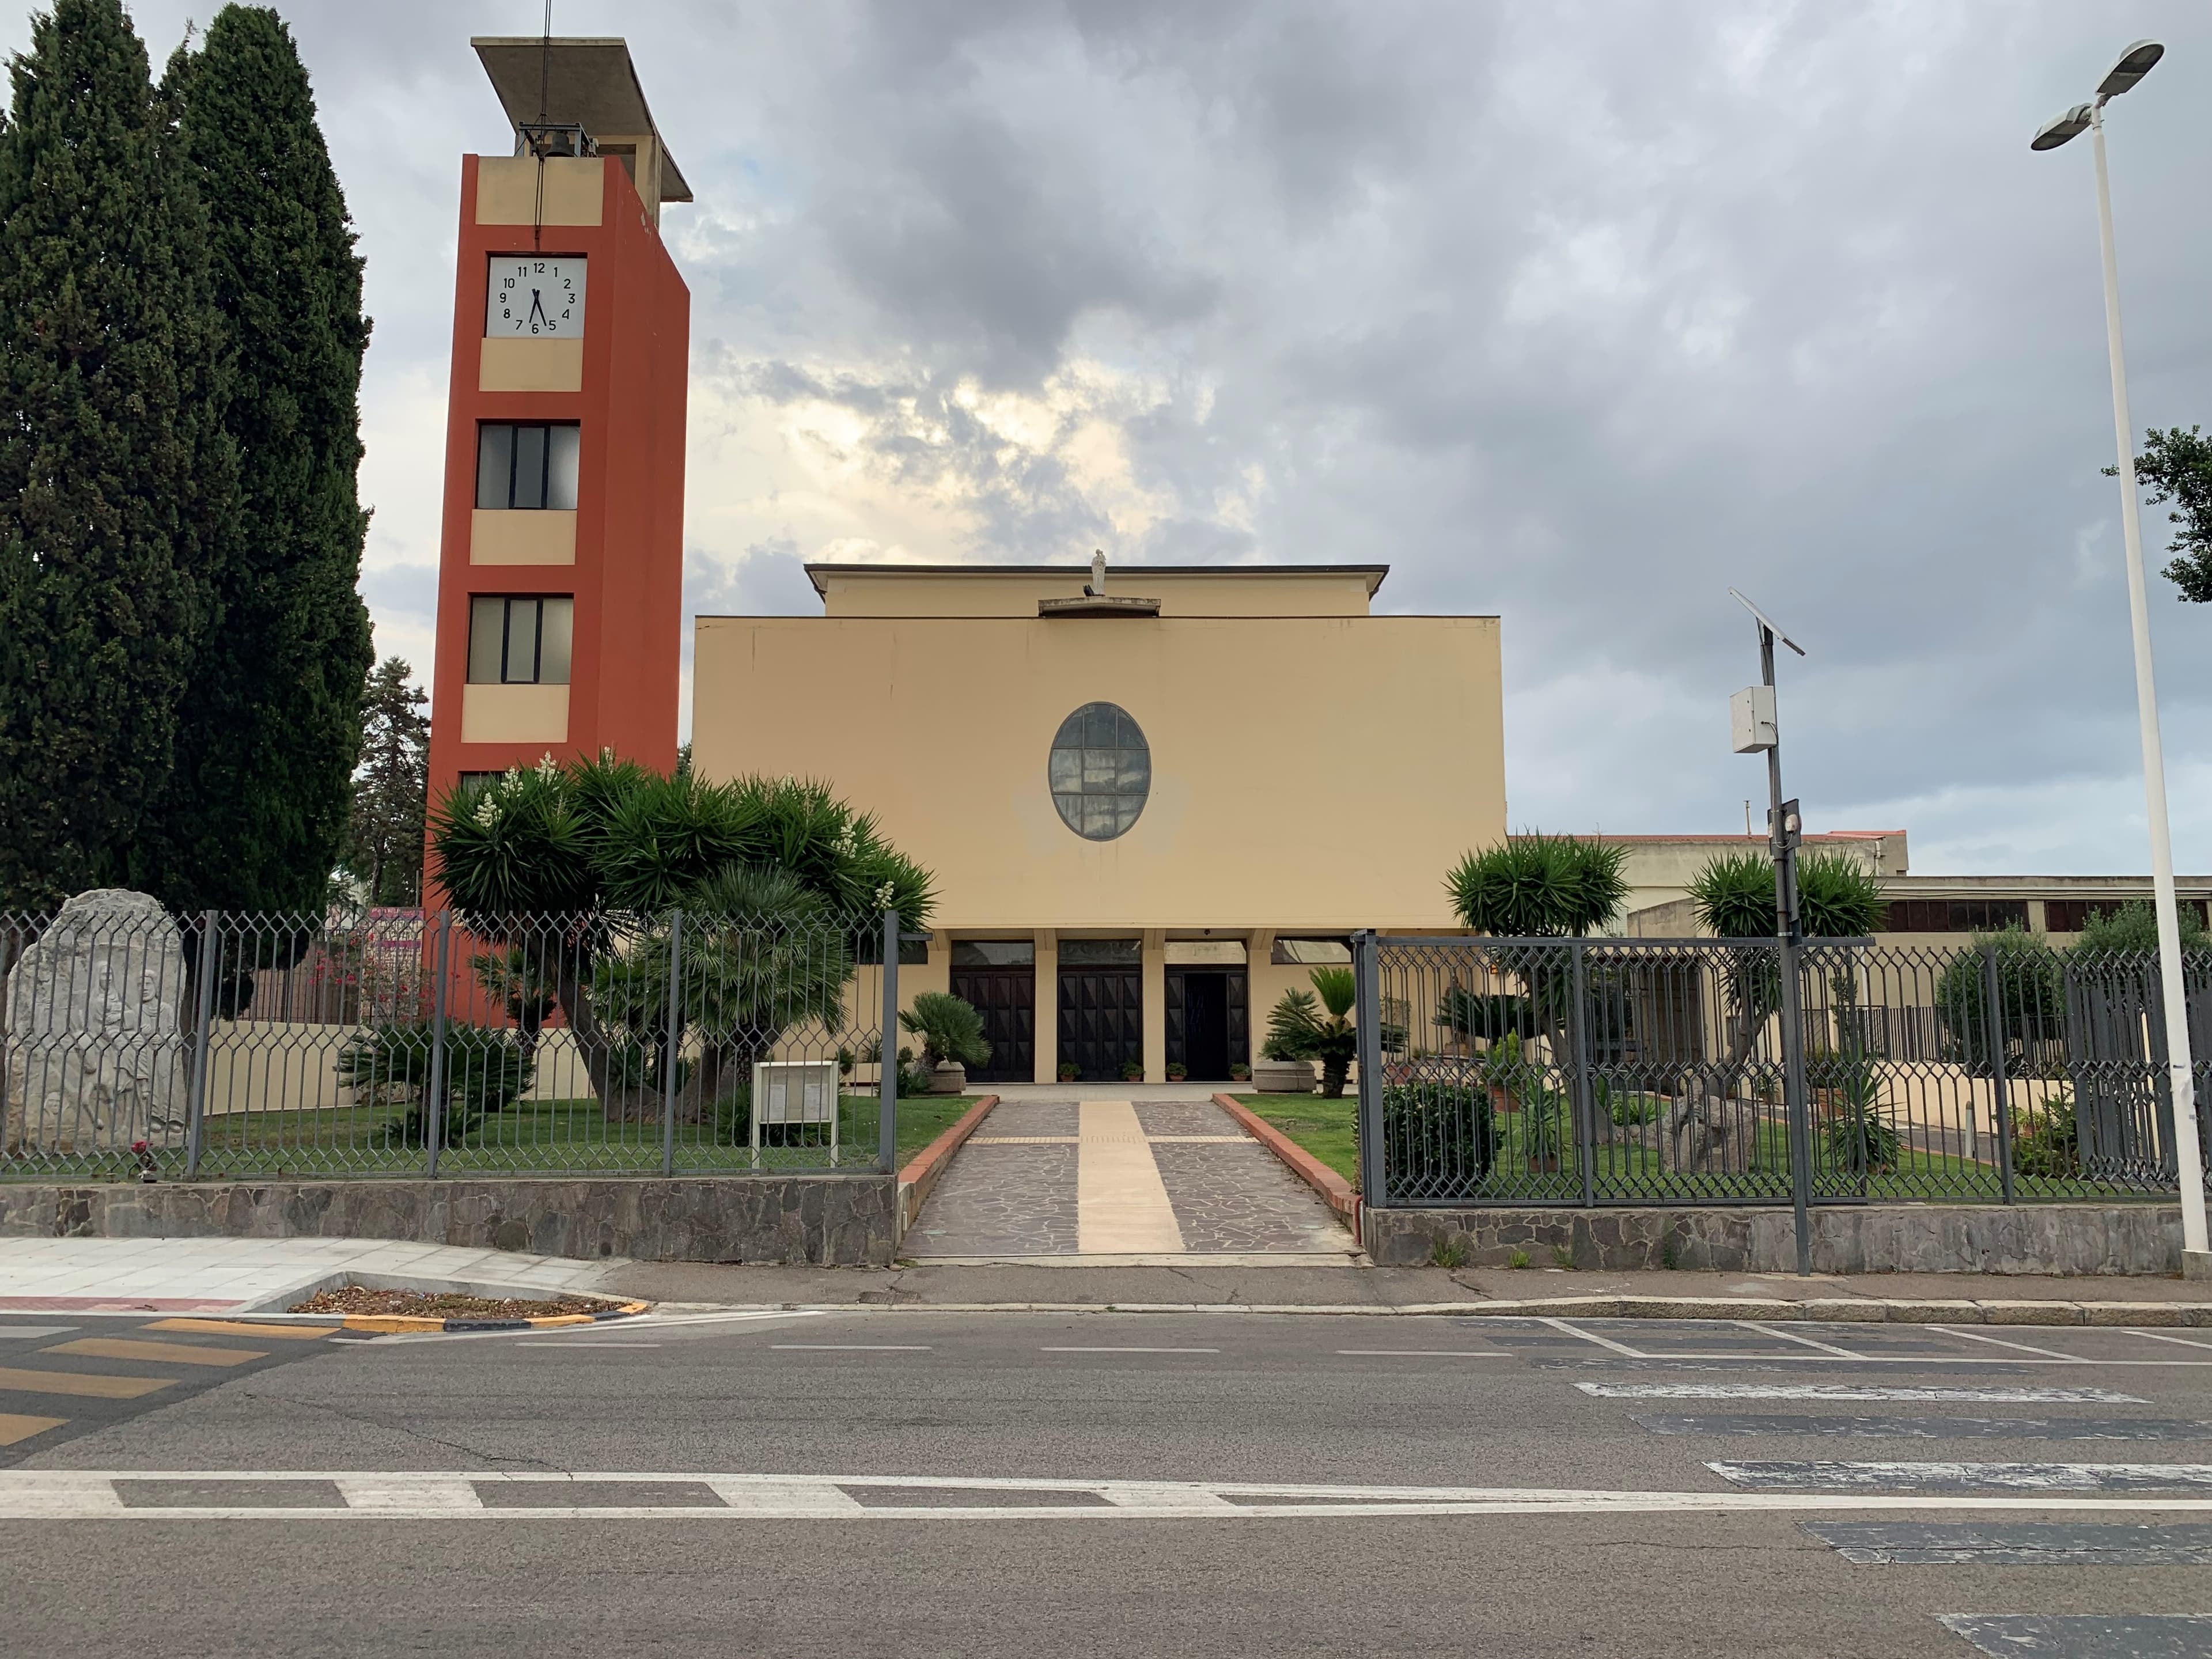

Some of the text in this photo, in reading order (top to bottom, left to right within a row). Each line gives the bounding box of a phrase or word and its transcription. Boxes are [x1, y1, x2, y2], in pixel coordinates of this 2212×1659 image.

[517, 267, 527, 277] 11
[533, 263, 545, 274] 12
[554, 267, 558, 278] 1
[503, 278, 515, 289] 10
[563, 278, 571, 289] 2
[499, 293, 506, 303] 9
[568, 293, 575, 304] 3
[503, 308, 510, 319] 8
[562, 309, 570, 320] 4
[516, 320, 523, 330] 7
[532, 324, 539, 334] 6
[548, 320, 556, 331] 5
